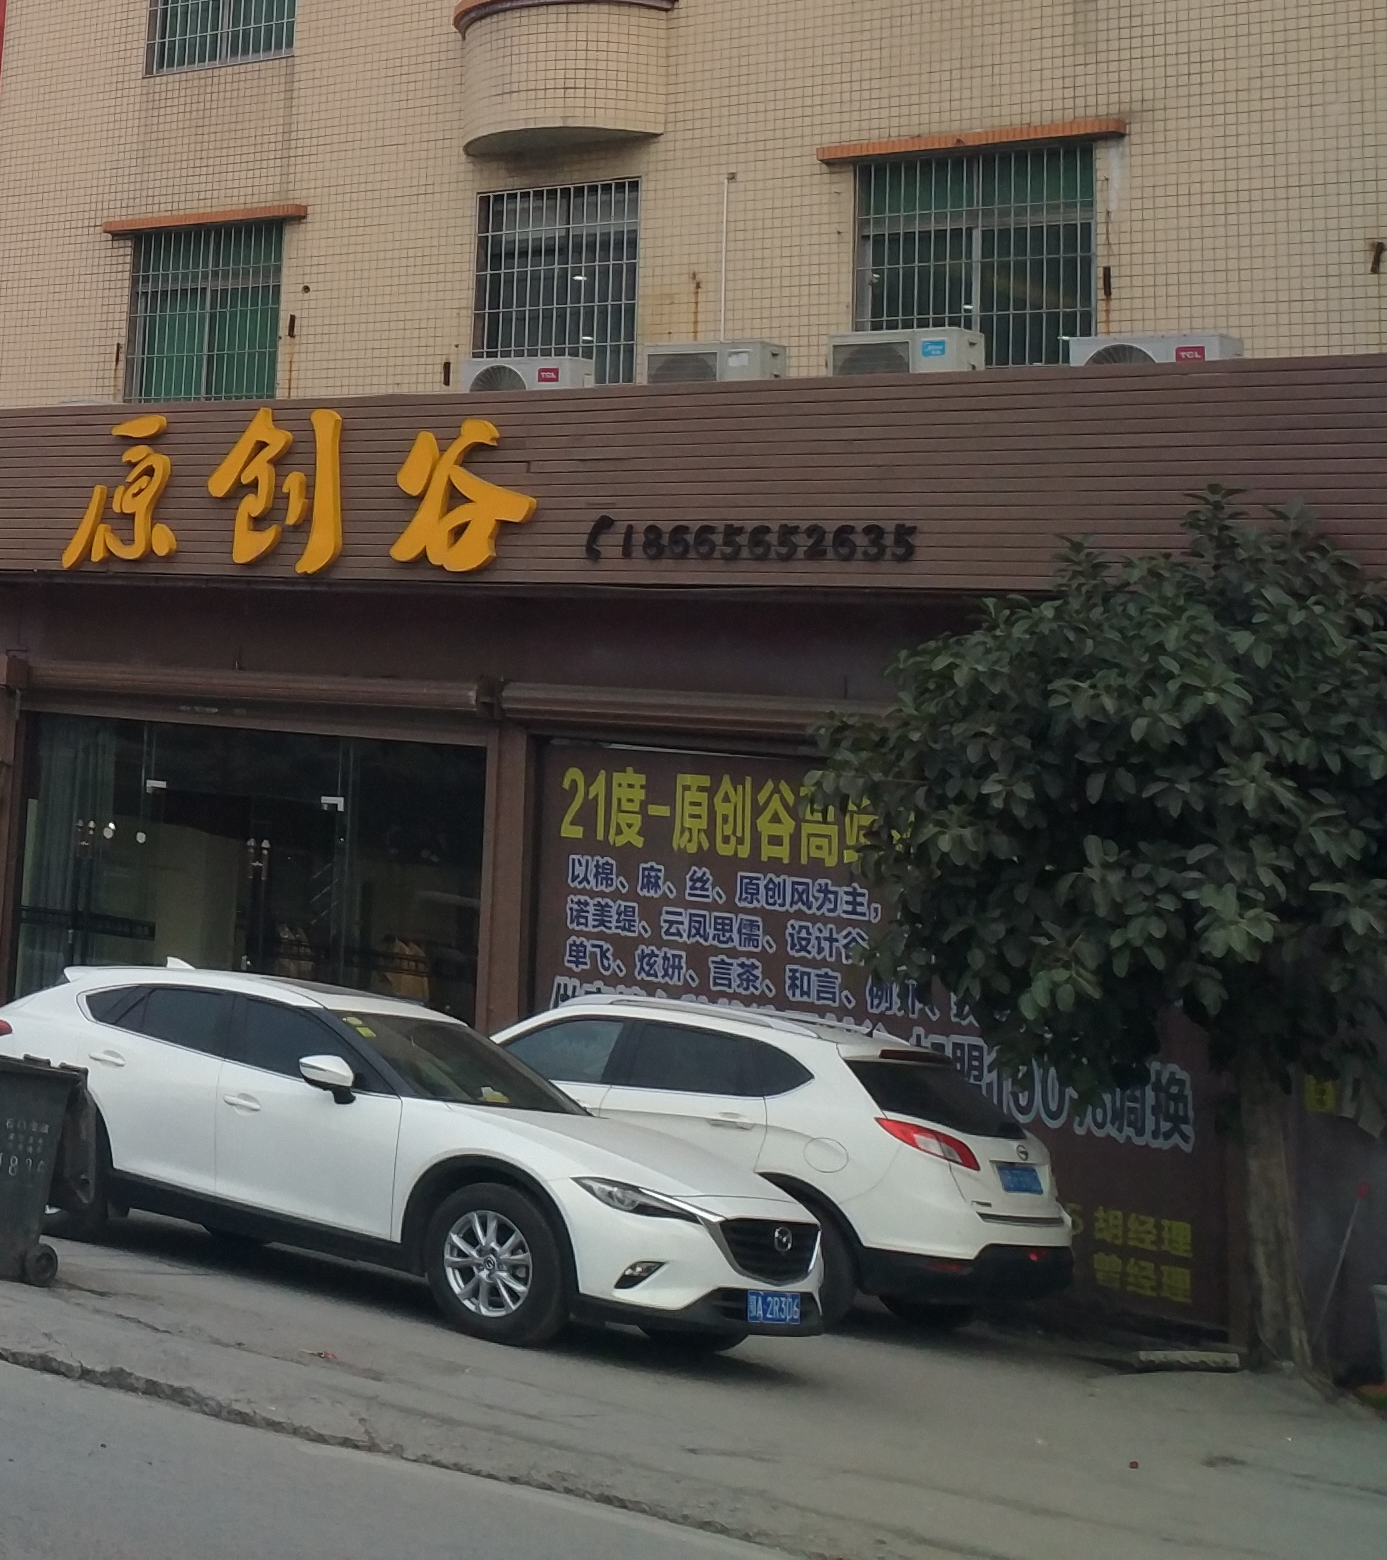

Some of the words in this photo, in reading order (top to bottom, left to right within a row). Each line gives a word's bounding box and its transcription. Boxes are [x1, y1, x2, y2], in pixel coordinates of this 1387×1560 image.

[1179, 350, 1203, 359] TCL
[61, 406, 538, 575] 原创谷
[621, 521, 919, 562] 18665652635
